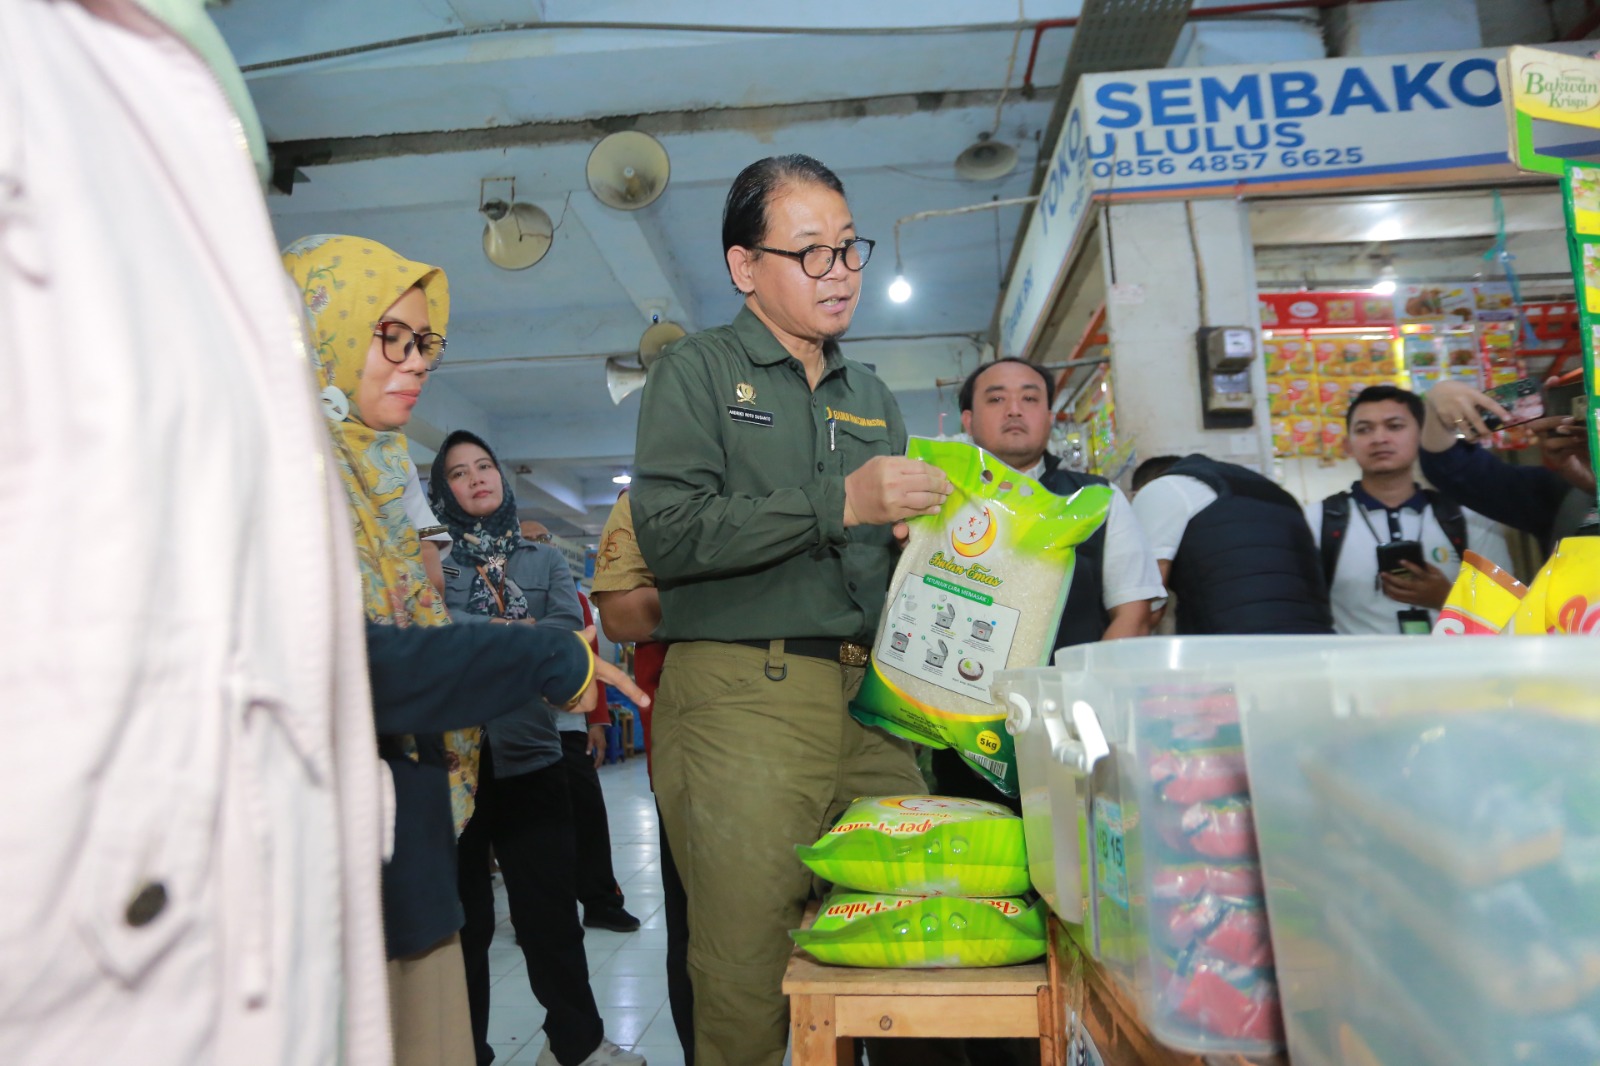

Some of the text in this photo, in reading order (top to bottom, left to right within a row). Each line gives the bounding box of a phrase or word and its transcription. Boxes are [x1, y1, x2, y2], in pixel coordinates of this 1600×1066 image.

[1095, 58, 1502, 129] SEMBAKO
[1524, 72, 1598, 95] Bakwan
[1548, 92, 1588, 109] Krispi
[1135, 122, 1306, 157] LULUS
[1040, 107, 1082, 236] TOKO
[1092, 158, 1175, 178] 0856
[1188, 152, 1269, 173] 4857
[1281, 146, 1364, 169] 6625
[929, 551, 1003, 587] Bulan Emas
